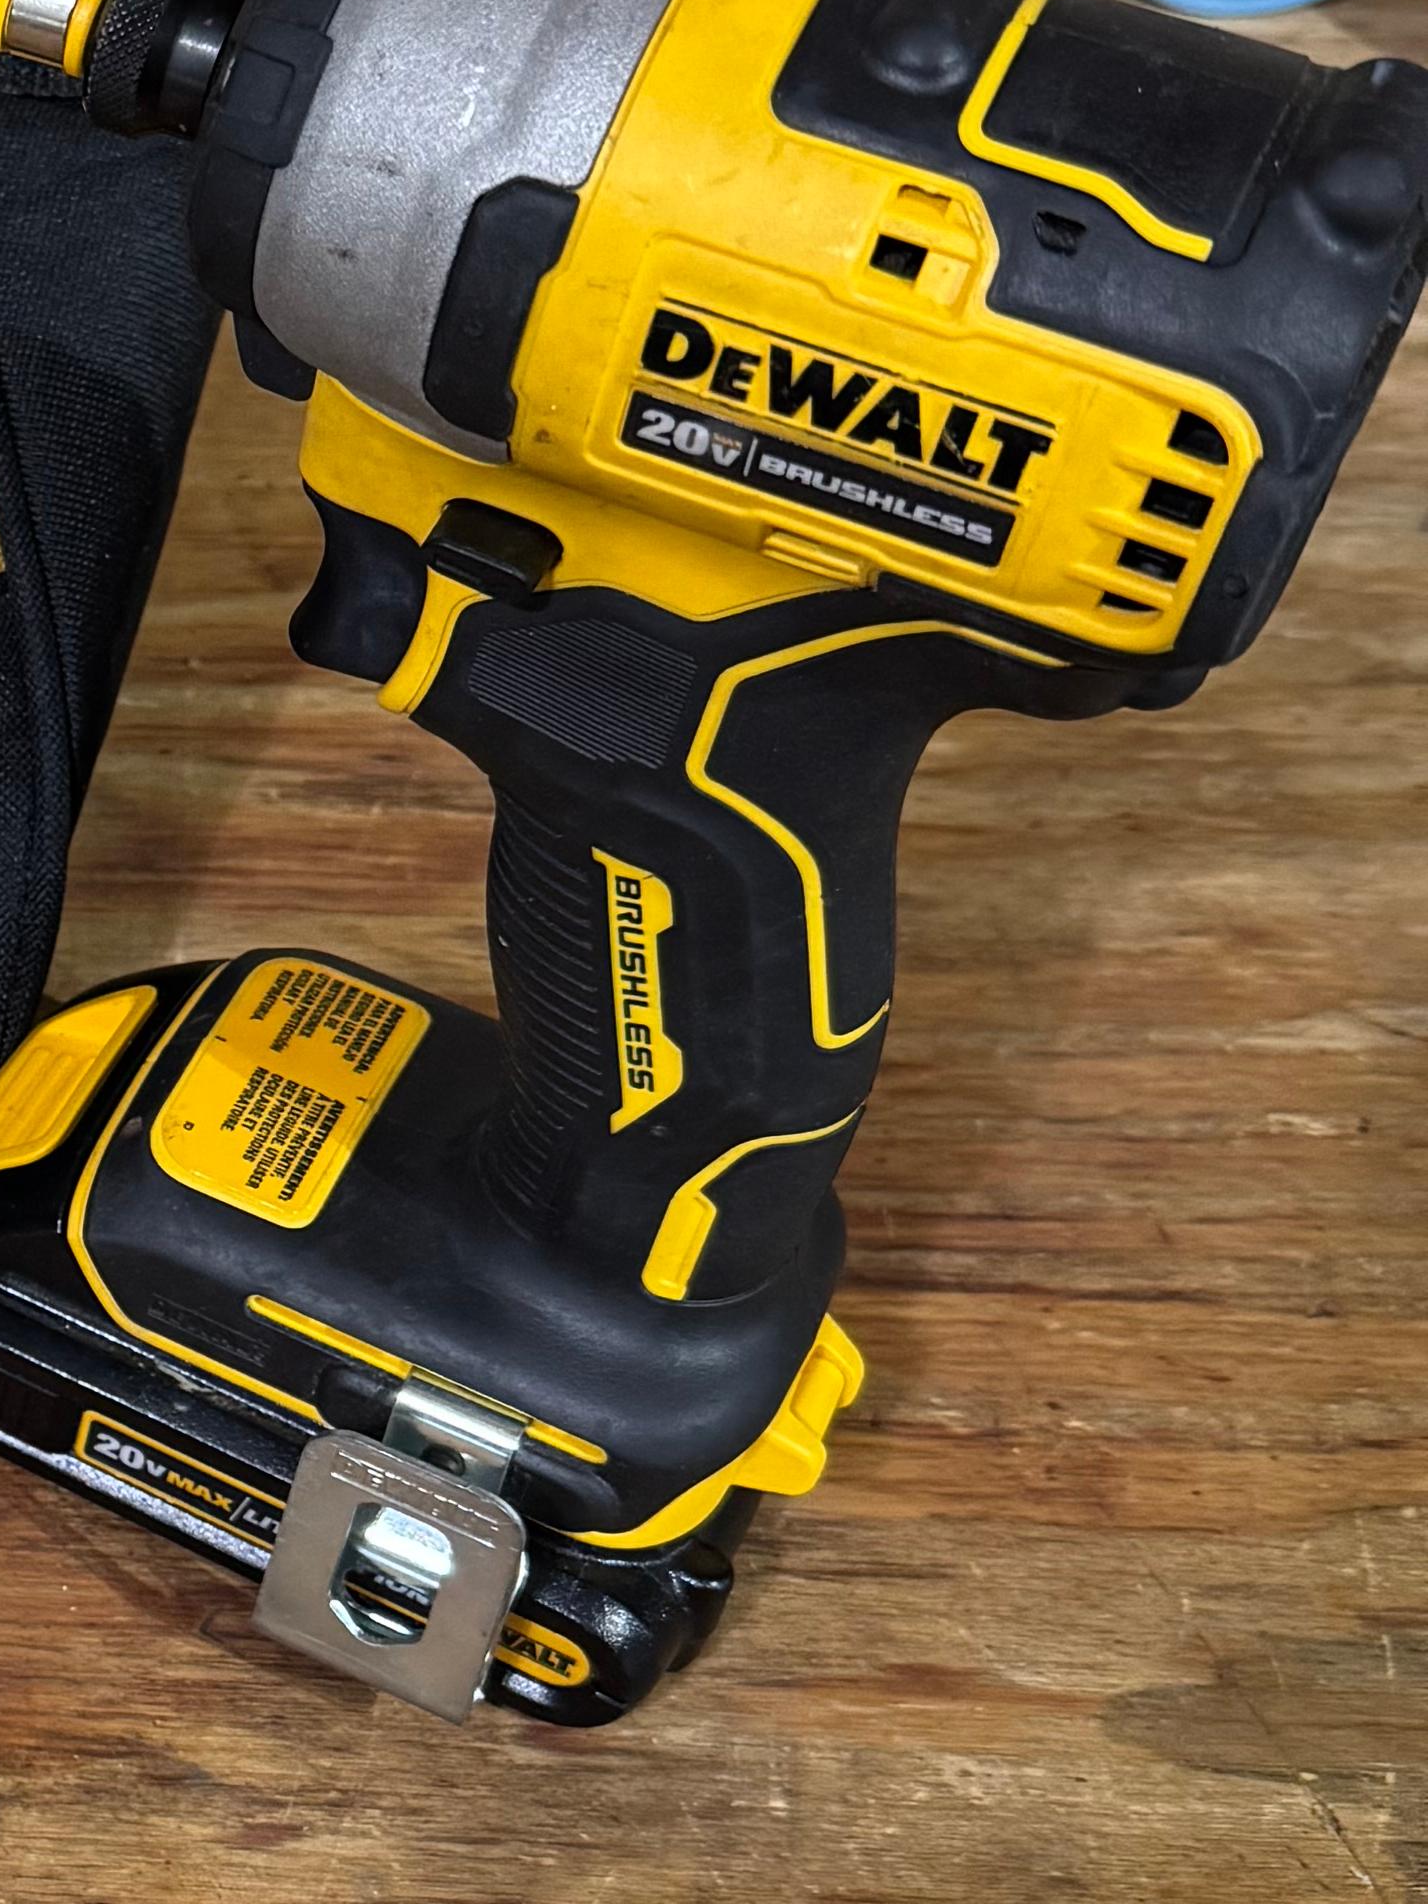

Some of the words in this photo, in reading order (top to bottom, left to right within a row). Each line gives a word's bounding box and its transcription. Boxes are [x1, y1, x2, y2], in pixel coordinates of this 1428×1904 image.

[641, 308, 1055, 492] DEWALT
[759, 454, 993, 546] BRUSHLESS
[615, 875, 654, 1092] BRUSHLESS
[248, 1072, 284, 1118] OCULAIRE
[278, 1079, 299, 1100] DES
[293, 1086, 315, 1108] LIRE
[240, 1117, 257, 1131] ET
[241, 1098, 288, 1162] PROTECTIONS
[300, 1101, 326, 1129] TITRE
[245, 1146, 279, 1189] UTILISER
[167, 1470, 234, 1513] MAX
